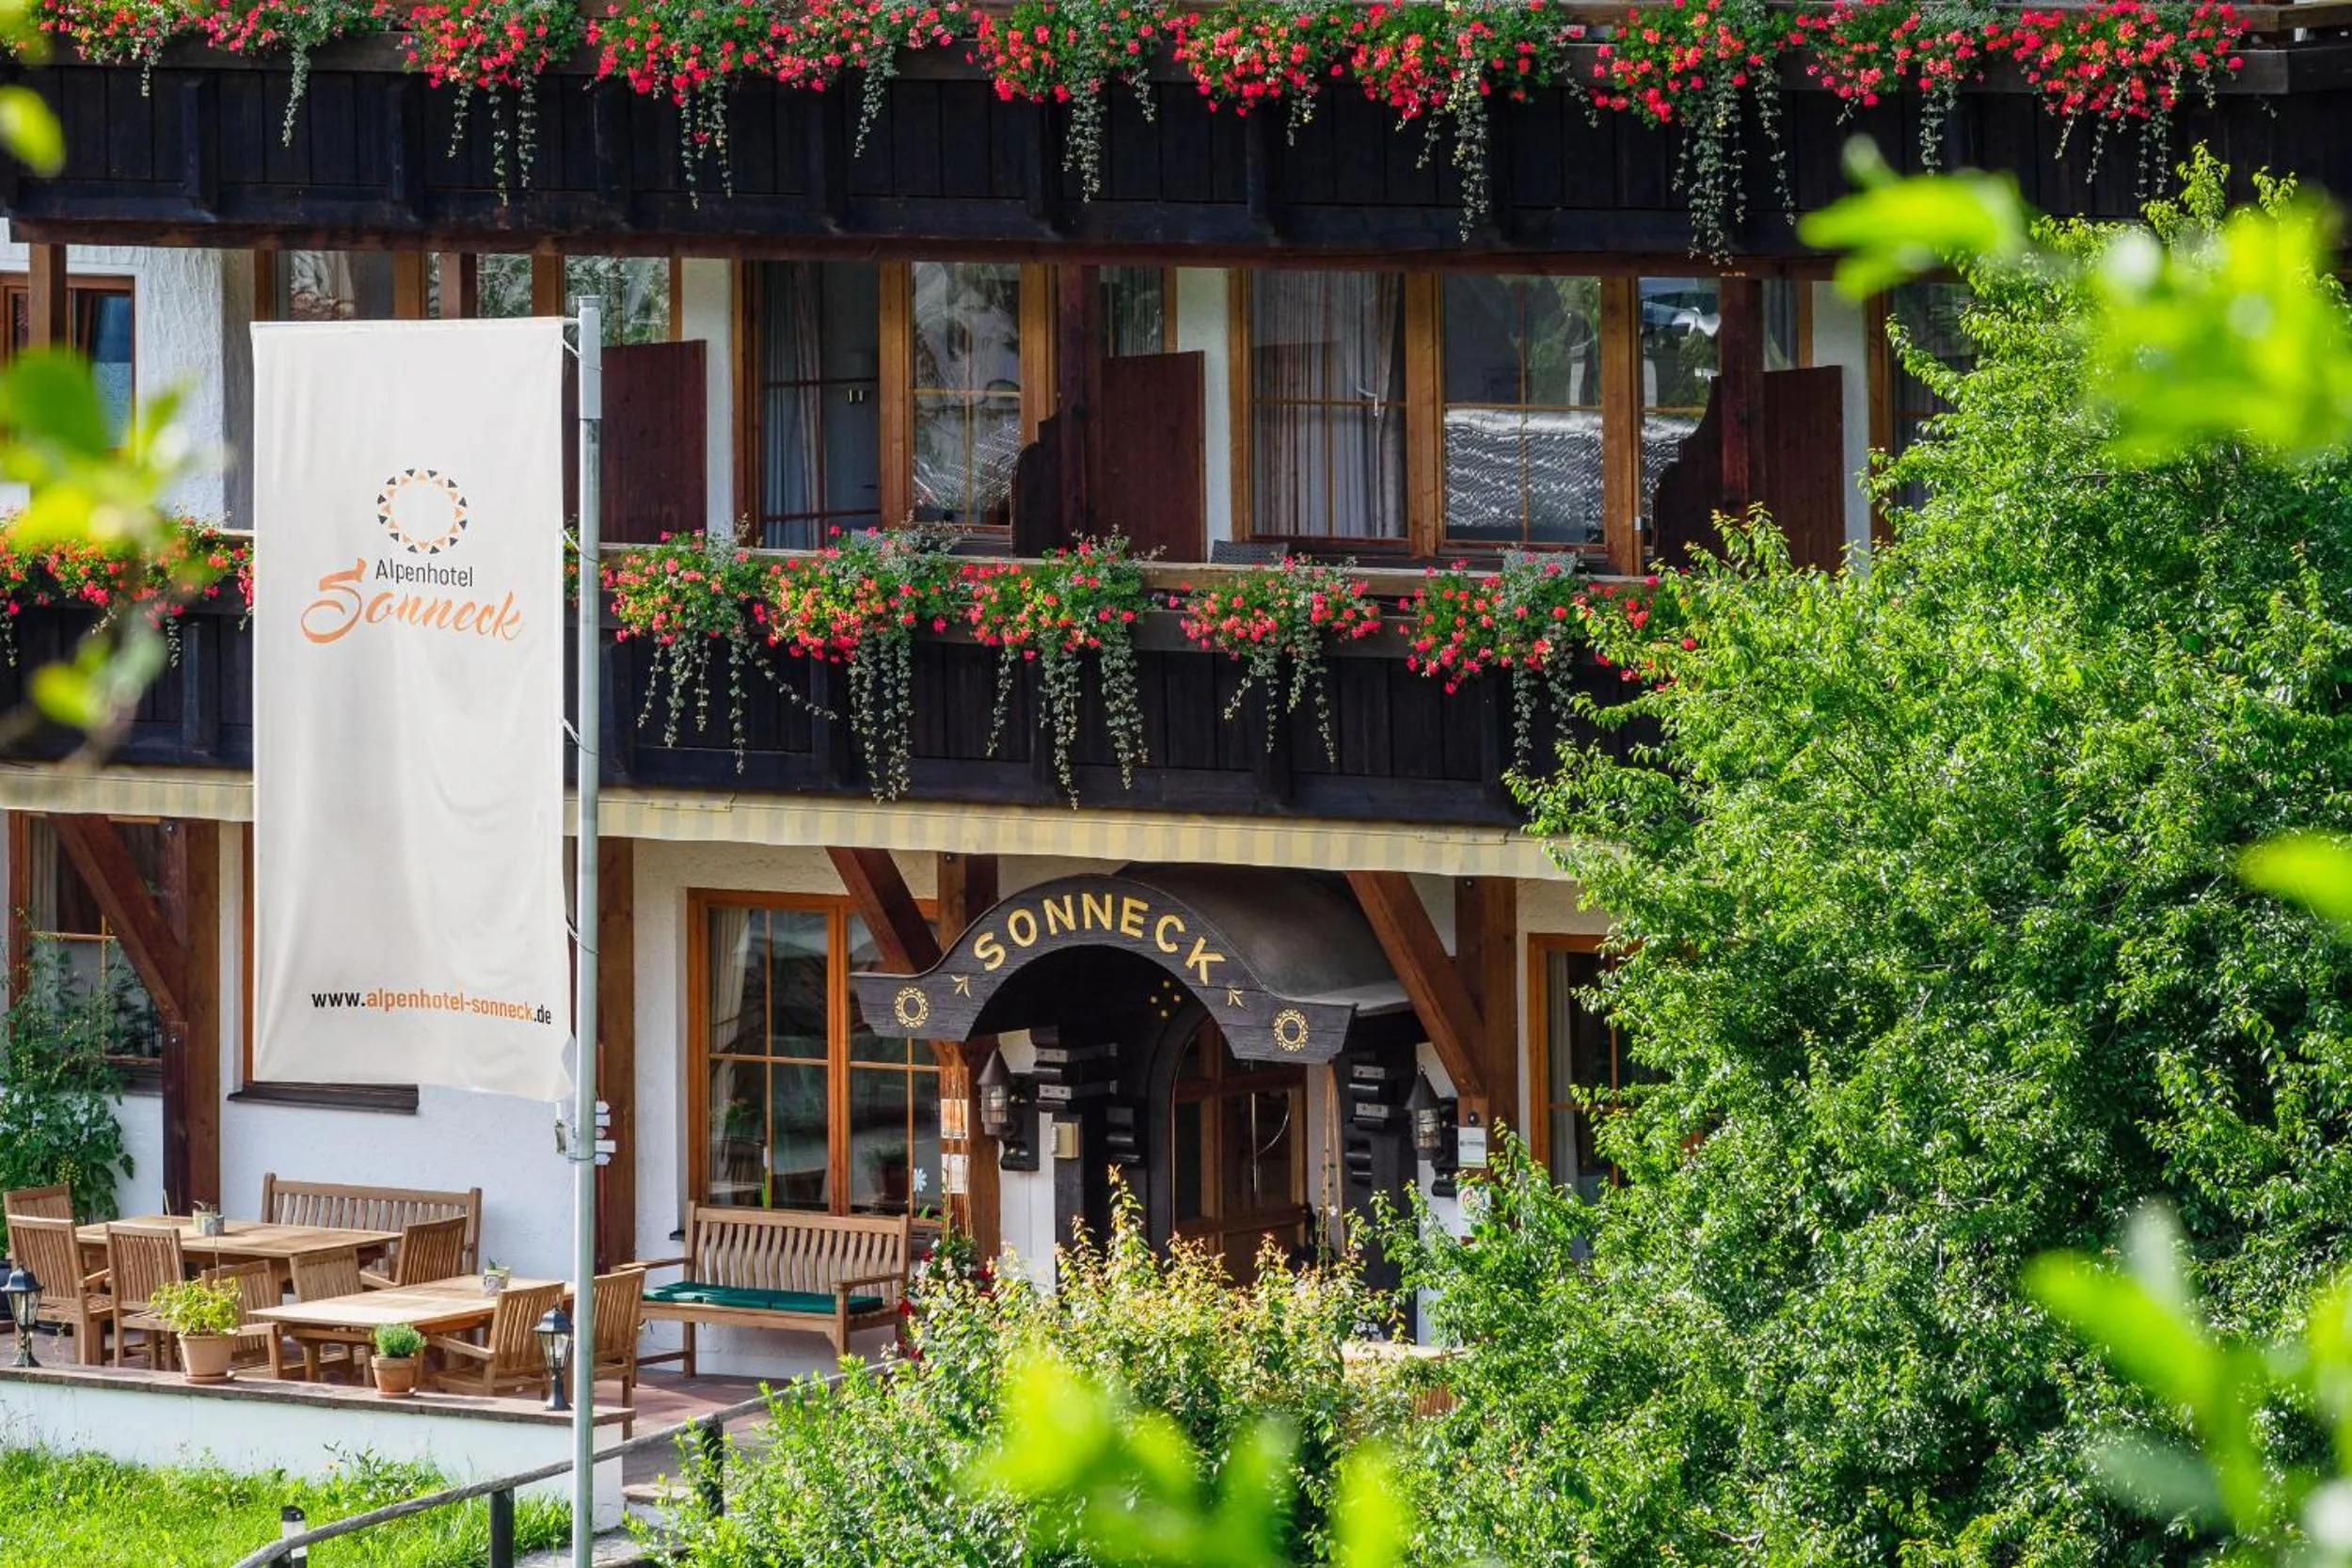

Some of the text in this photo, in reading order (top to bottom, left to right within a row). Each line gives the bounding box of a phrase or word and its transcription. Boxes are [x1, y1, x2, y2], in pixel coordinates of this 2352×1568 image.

[300, 557, 523, 643] Sonneck
[376, 559, 472, 586] Alpenhotel
[974, 893, 1226, 985] SONNECK
[311, 989, 551, 1025] www.alpenhotel-sonneck.de
